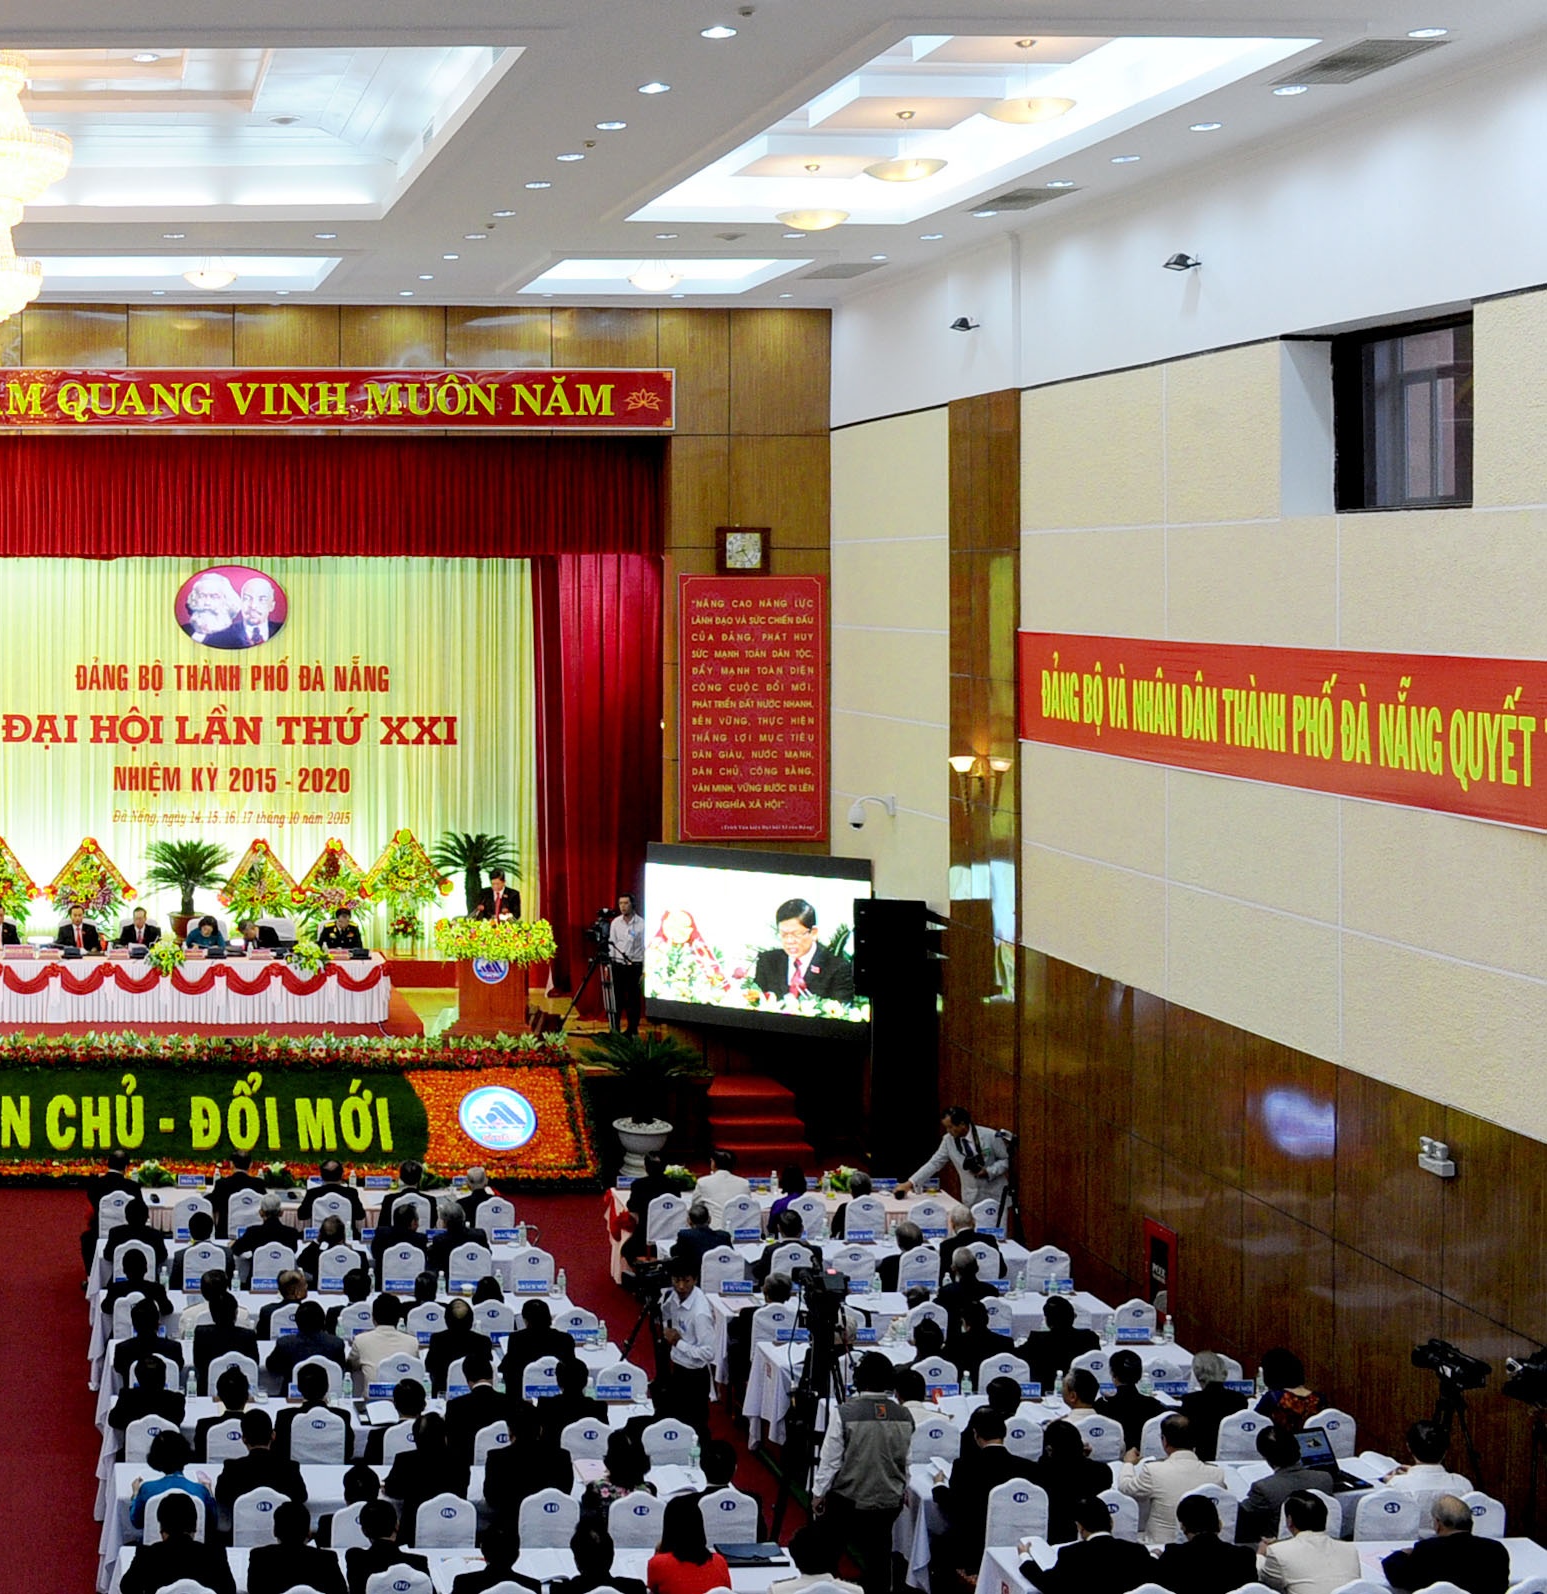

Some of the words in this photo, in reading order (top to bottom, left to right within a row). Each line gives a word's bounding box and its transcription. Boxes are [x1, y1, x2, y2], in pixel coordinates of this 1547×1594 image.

[57, 383, 215, 423] QUANG
[228, 383, 351, 416] VINH
[364, 374, 499, 416] MUÔN
[512, 376, 616, 417] NĂM
[75, 657, 130, 693] ĐẢNG
[139, 658, 165, 698] BỘ
[175, 657, 242, 693] THÀNH
[251, 656, 290, 693] PHỐ
[299, 657, 326, 693] ĐÀ
[335, 656, 391, 693] NẴNG
[2, 714, 80, 751] ĐẠI
[90, 706, 166, 752] HỘI
[176, 704, 265, 747] LẦN
[277, 707, 371, 747] THỨ
[380, 716, 459, 747] XXI
[1041, 651, 1080, 719] ĐẢNG
[1083, 662, 1104, 736] BỘ
[1108, 664, 1129, 730] VÀ
[1133, 667, 1177, 737] NHÂN
[1182, 670, 1218, 743] DÂN
[1222, 675, 1287, 753] THÀNH
[1292, 674, 1338, 760] PHỐ
[1341, 684, 1372, 766] ĐÀ
[1379, 677, 1444, 776] NẴNG
[1450, 686, 1536, 792] QUYẾT
[114, 761, 183, 798] NHIỆM
[192, 763, 220, 794] KỲ
[230, 768, 278, 795] 2015
[300, 768, 352, 795] 2020
[112, 809, 128, 823] Đà
[162, 811, 187, 827] ngày
[242, 811, 254, 824] 17
[256, 811, 286, 828] tháng
[288, 811, 301, 824] 10
[302, 811, 324, 824] năm
[326, 811, 352, 825] 2015
[46, 1073, 146, 1151] CHỦ
[159, 1118, 176, 1132] -
[190, 1071, 282, 1152] ĐỔI
[295, 1079, 395, 1152] MỚI
